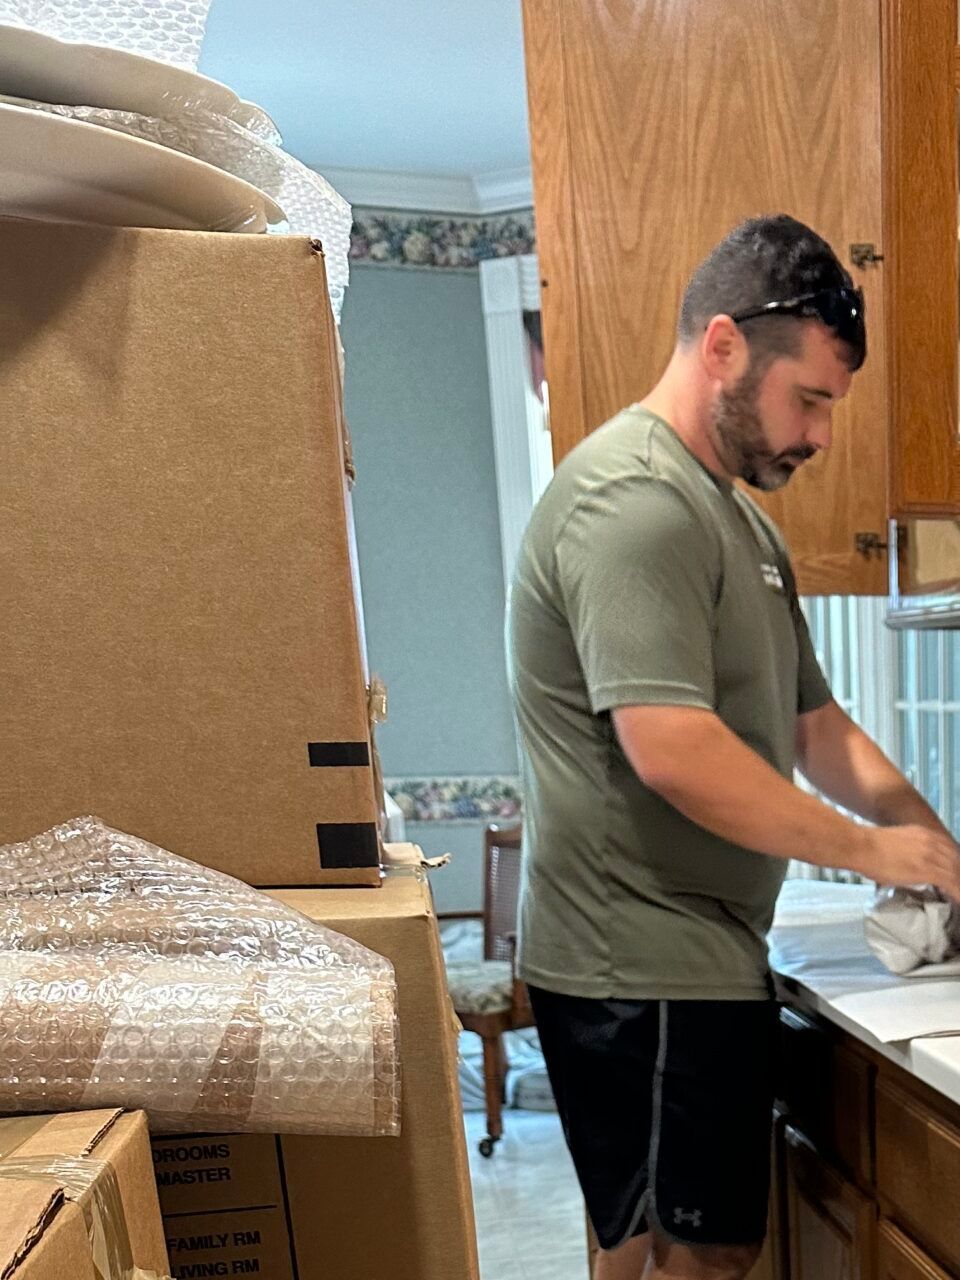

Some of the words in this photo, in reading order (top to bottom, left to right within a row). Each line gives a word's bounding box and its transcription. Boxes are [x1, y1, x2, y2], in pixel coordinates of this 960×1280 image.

[152, 1144, 231, 1164] DROOMS
[156, 1167, 231, 1186] MASTER
[166, 1233, 229, 1253] FAMILY
[233, 1230, 262, 1246] RM
[171, 1261, 228, 1280] LIVING
[232, 1258, 260, 1274] RM
